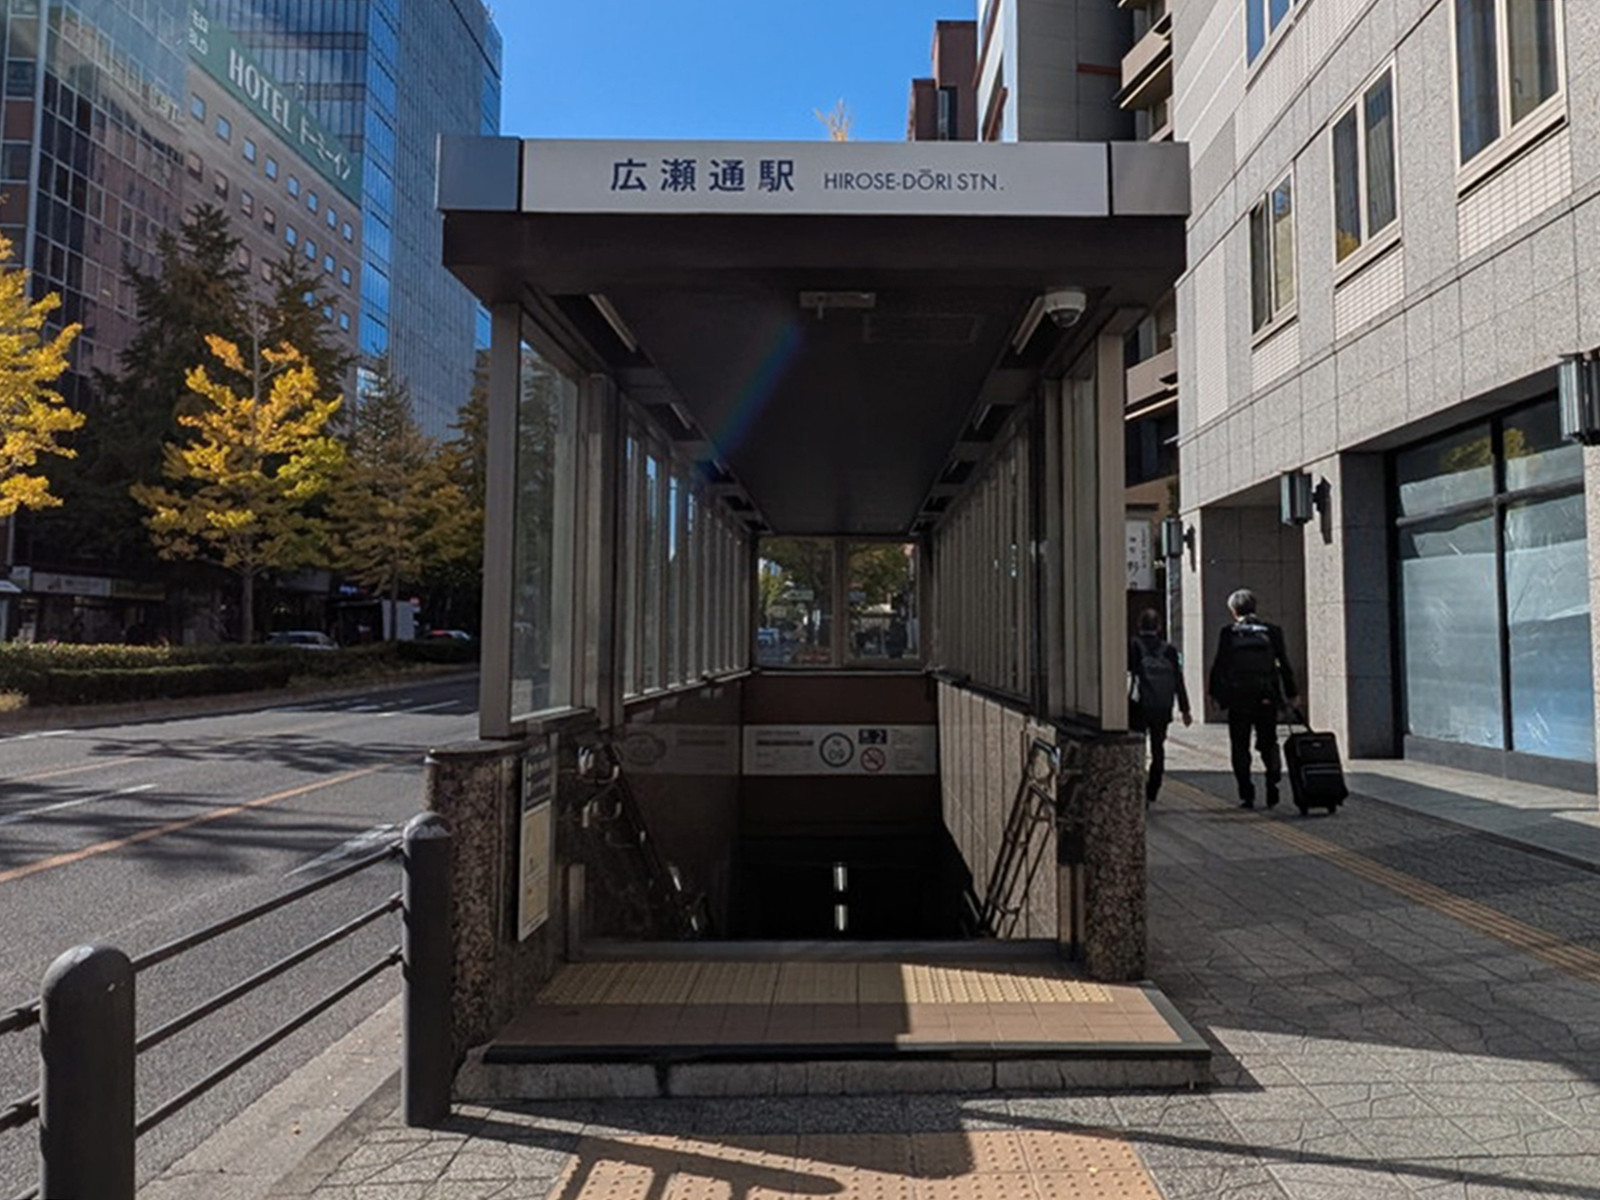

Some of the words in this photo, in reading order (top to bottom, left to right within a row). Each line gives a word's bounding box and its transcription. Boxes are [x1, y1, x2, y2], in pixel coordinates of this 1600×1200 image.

[229, 48, 292, 134] HOTEL
[301, 115, 351, 180] ドーミーイン
[611, 158, 795, 192] 広瀬通駅
[824, 168, 952, 191] HIROSE-DŌRI
[957, 172, 1004, 191] STN.
